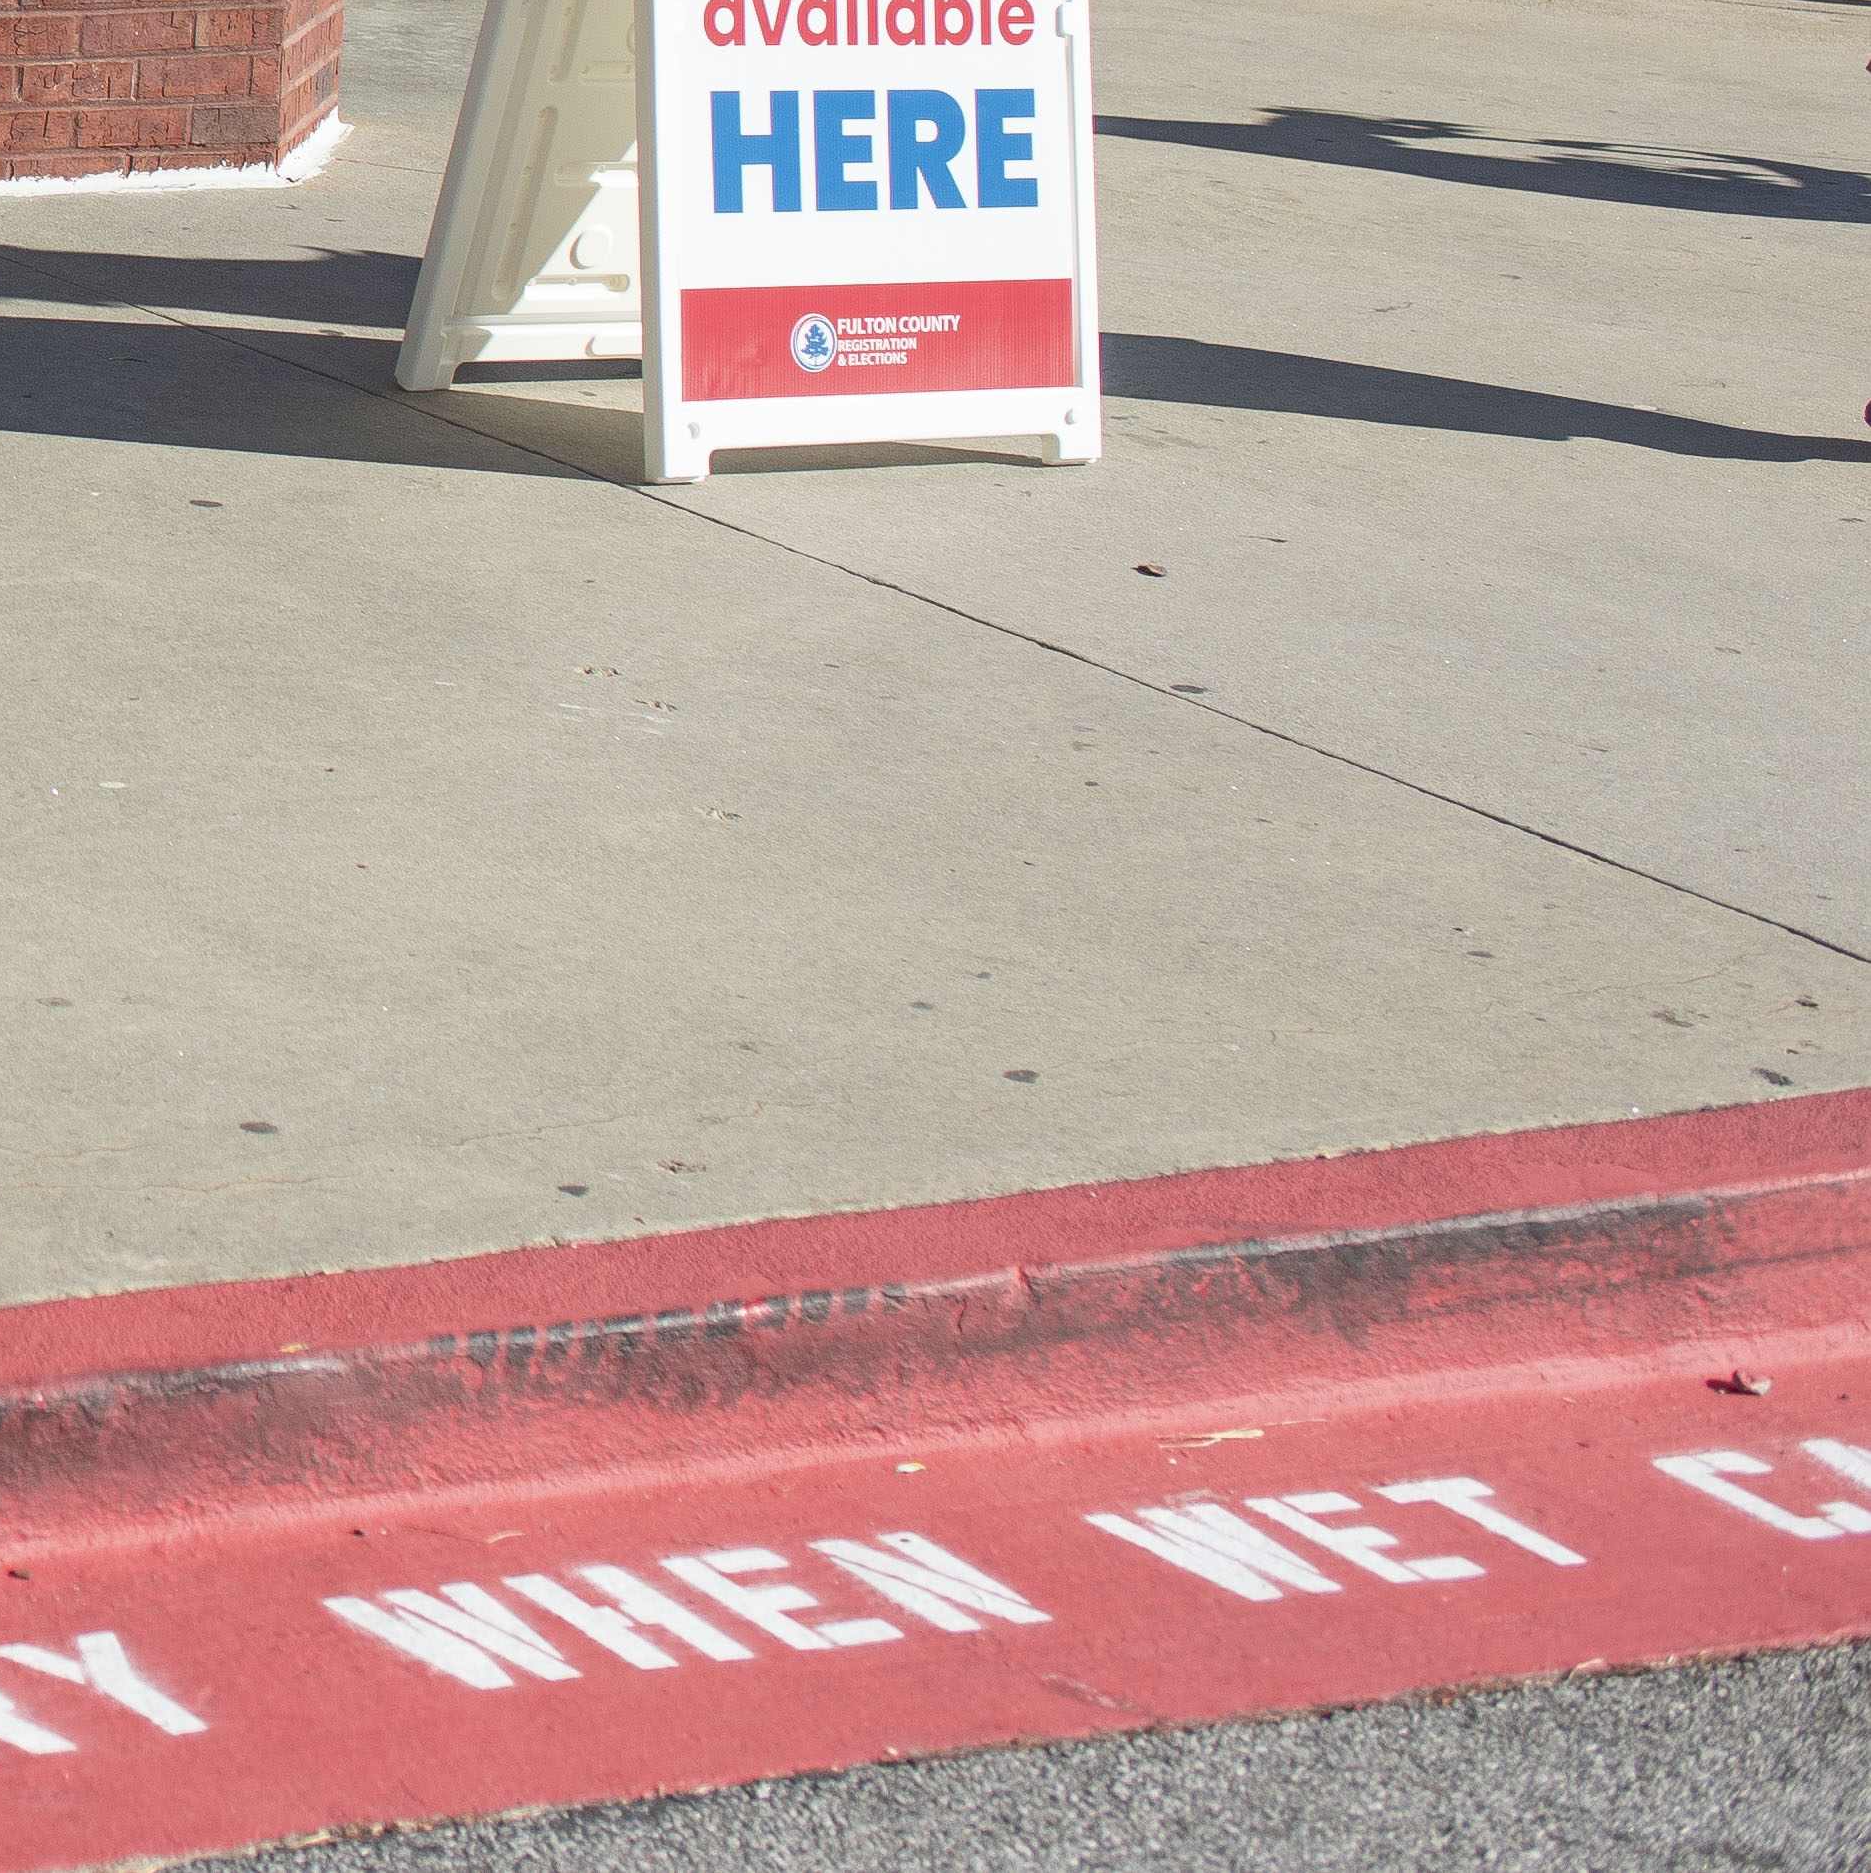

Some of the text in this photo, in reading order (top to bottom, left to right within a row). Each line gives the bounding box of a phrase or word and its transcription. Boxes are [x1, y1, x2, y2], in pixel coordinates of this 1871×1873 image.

[710, 88, 1039, 213] HERE
[837, 314, 961, 335] FULTON COUNTY
[837, 337, 917, 352] REGISTRATION
[837, 352, 908, 366] & ELECTIONS
[321, 1531, 1052, 1690] WHEN
[1083, 1476, 1585, 1602] WET
